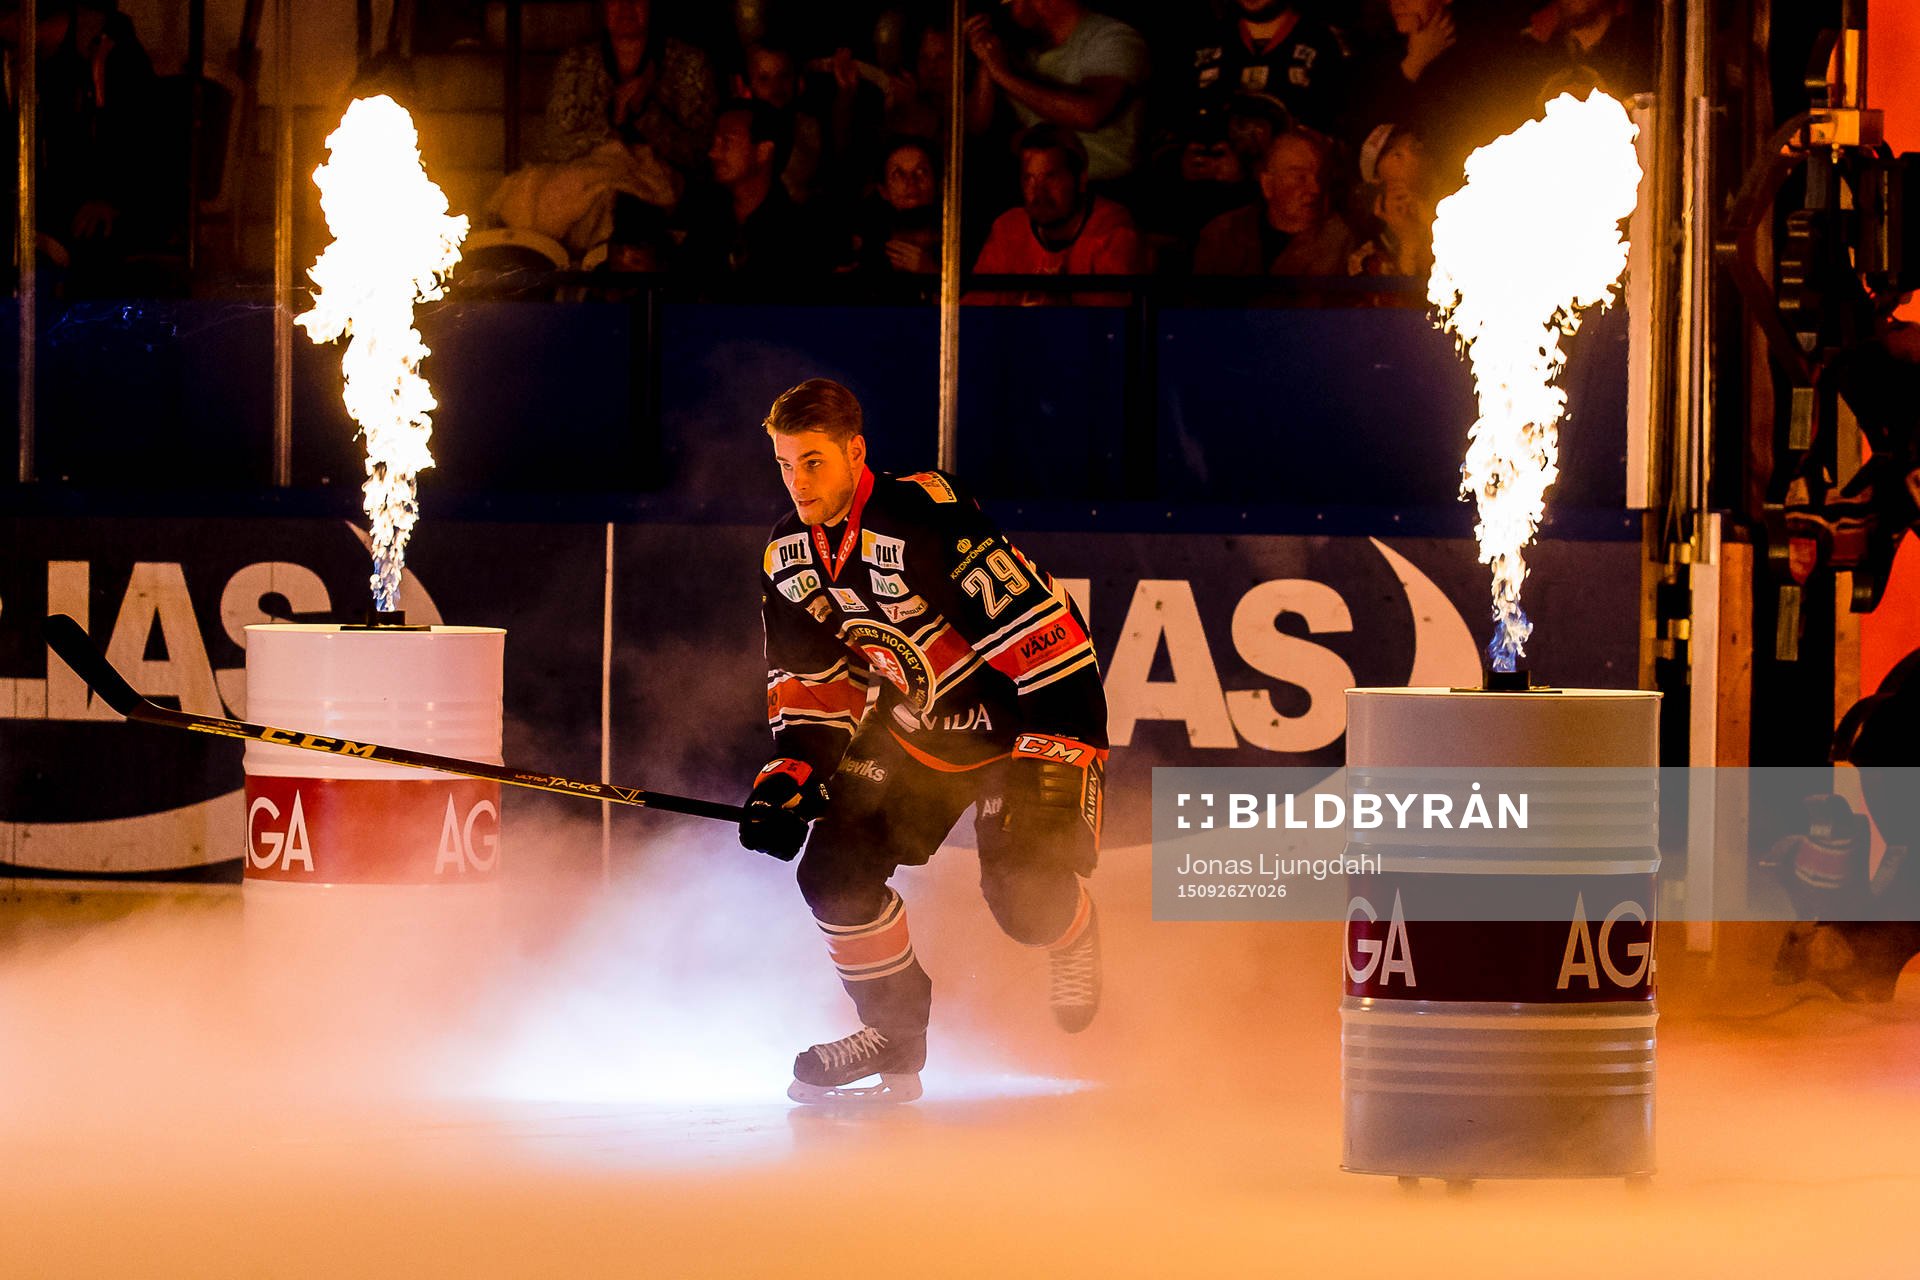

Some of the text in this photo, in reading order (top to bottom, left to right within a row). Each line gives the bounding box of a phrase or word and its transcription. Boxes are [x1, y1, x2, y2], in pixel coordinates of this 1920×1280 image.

[779, 538, 808, 567] put
[840, 530, 856, 561] CCM
[950, 537, 995, 580] KRONFÖNSTER
[961, 549, 1031, 620] 29
[882, 632, 922, 672] HOCKEY
[1020, 624, 1067, 659] VÄXJÖ
[1054, 578, 1356, 753] AS
[920, 703, 993, 731] VIDA
[260, 726, 377, 758] CCM
[1016, 735, 1083, 763] CM
[514, 774, 602, 793] ULTRA TACKS
[246, 789, 315, 872] GA
[1345, 888, 1416, 987] GA
